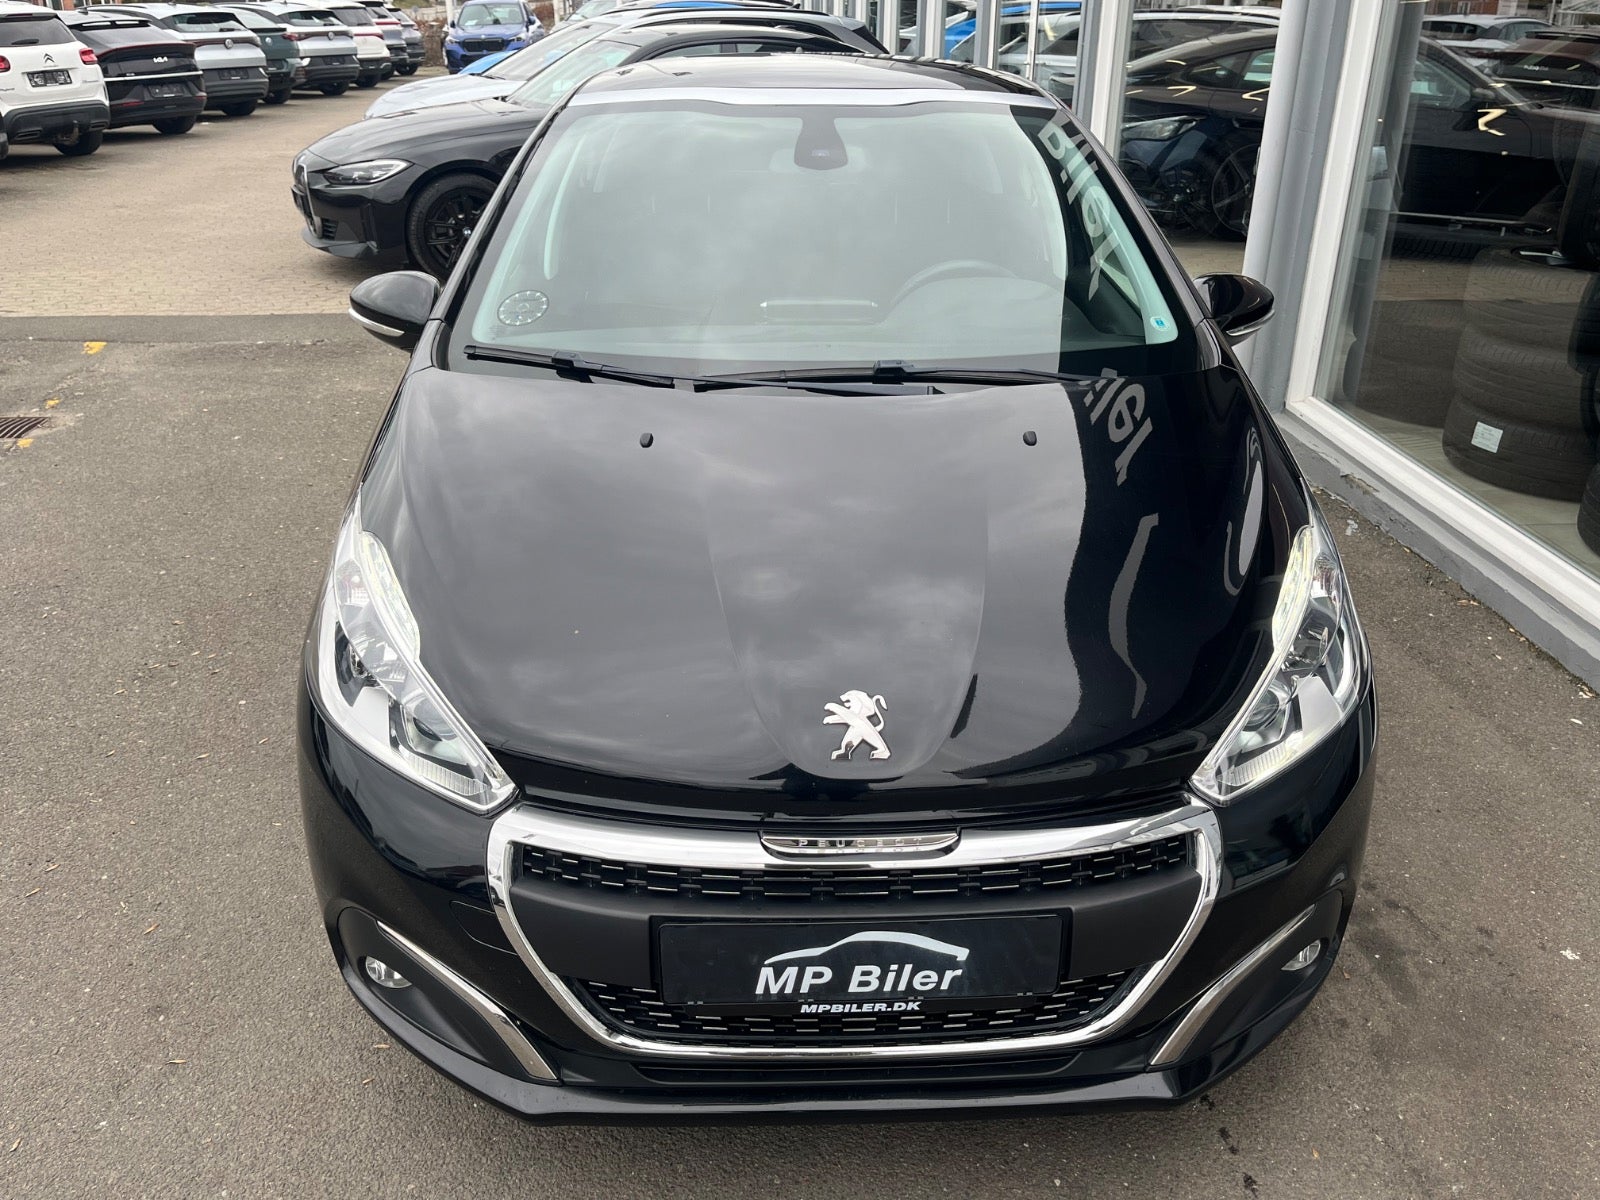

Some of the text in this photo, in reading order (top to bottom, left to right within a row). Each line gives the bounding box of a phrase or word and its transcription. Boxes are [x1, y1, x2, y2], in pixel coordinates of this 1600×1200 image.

[755, 963, 963, 994] MP Biler
[800, 1001, 921, 1014] MPBILER.DK
